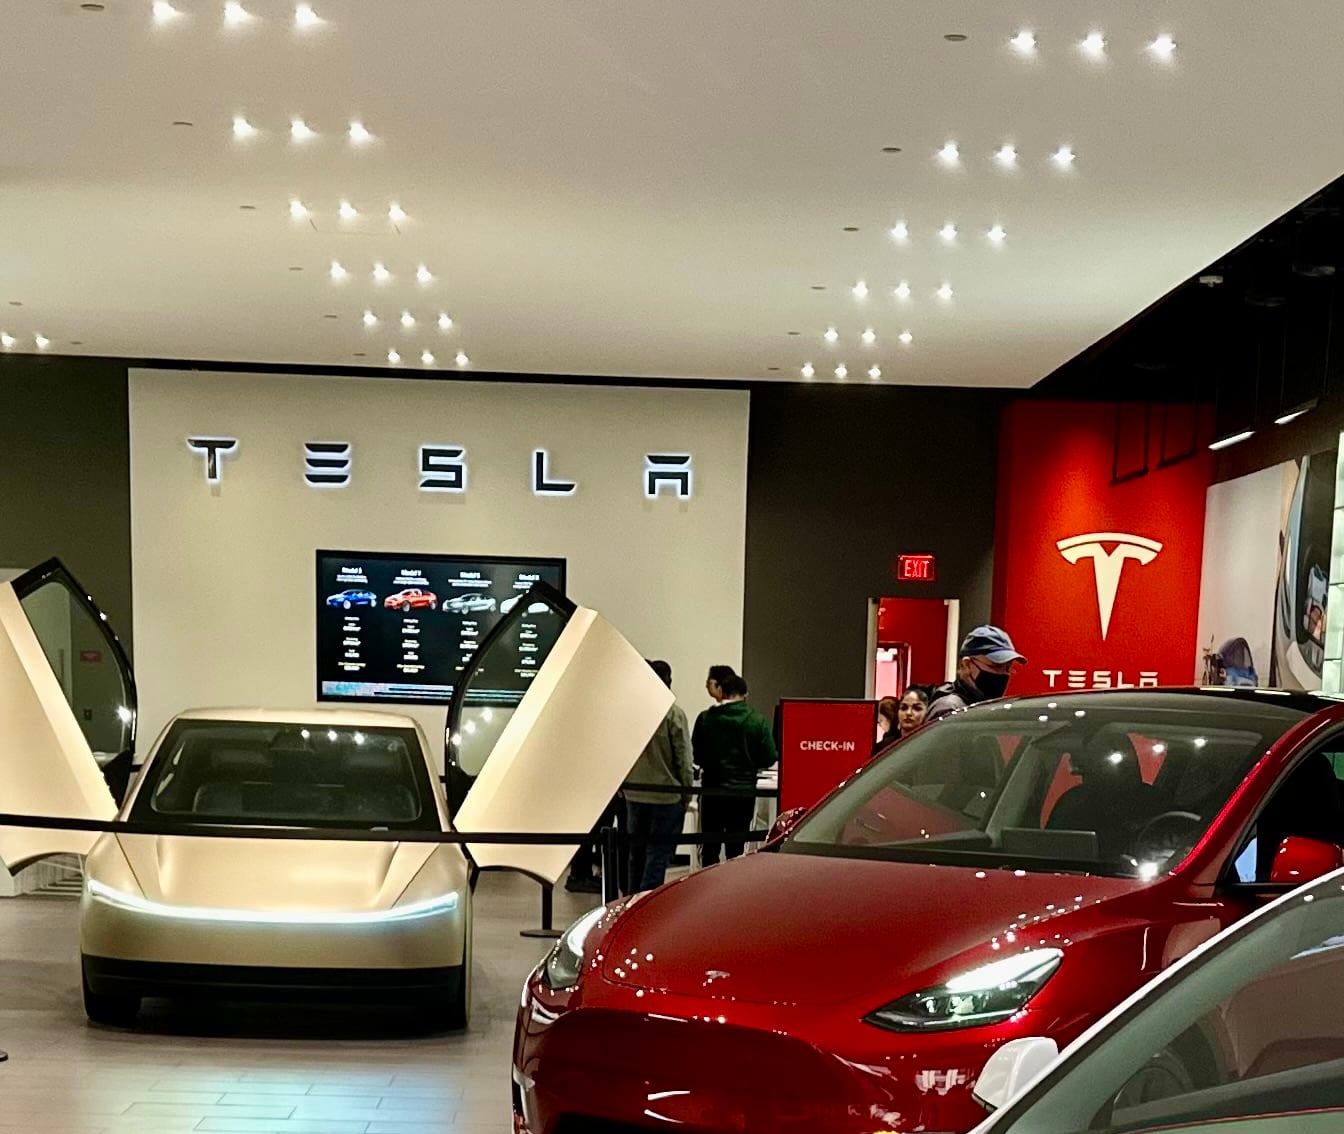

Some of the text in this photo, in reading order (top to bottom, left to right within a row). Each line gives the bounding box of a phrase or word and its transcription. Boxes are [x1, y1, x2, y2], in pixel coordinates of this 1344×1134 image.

[186, 437, 691, 496] TESLA
[903, 559, 930, 578] EXIT
[1042, 669, 1159, 688] TESLA
[799, 740, 855, 752] CHECK-IN
